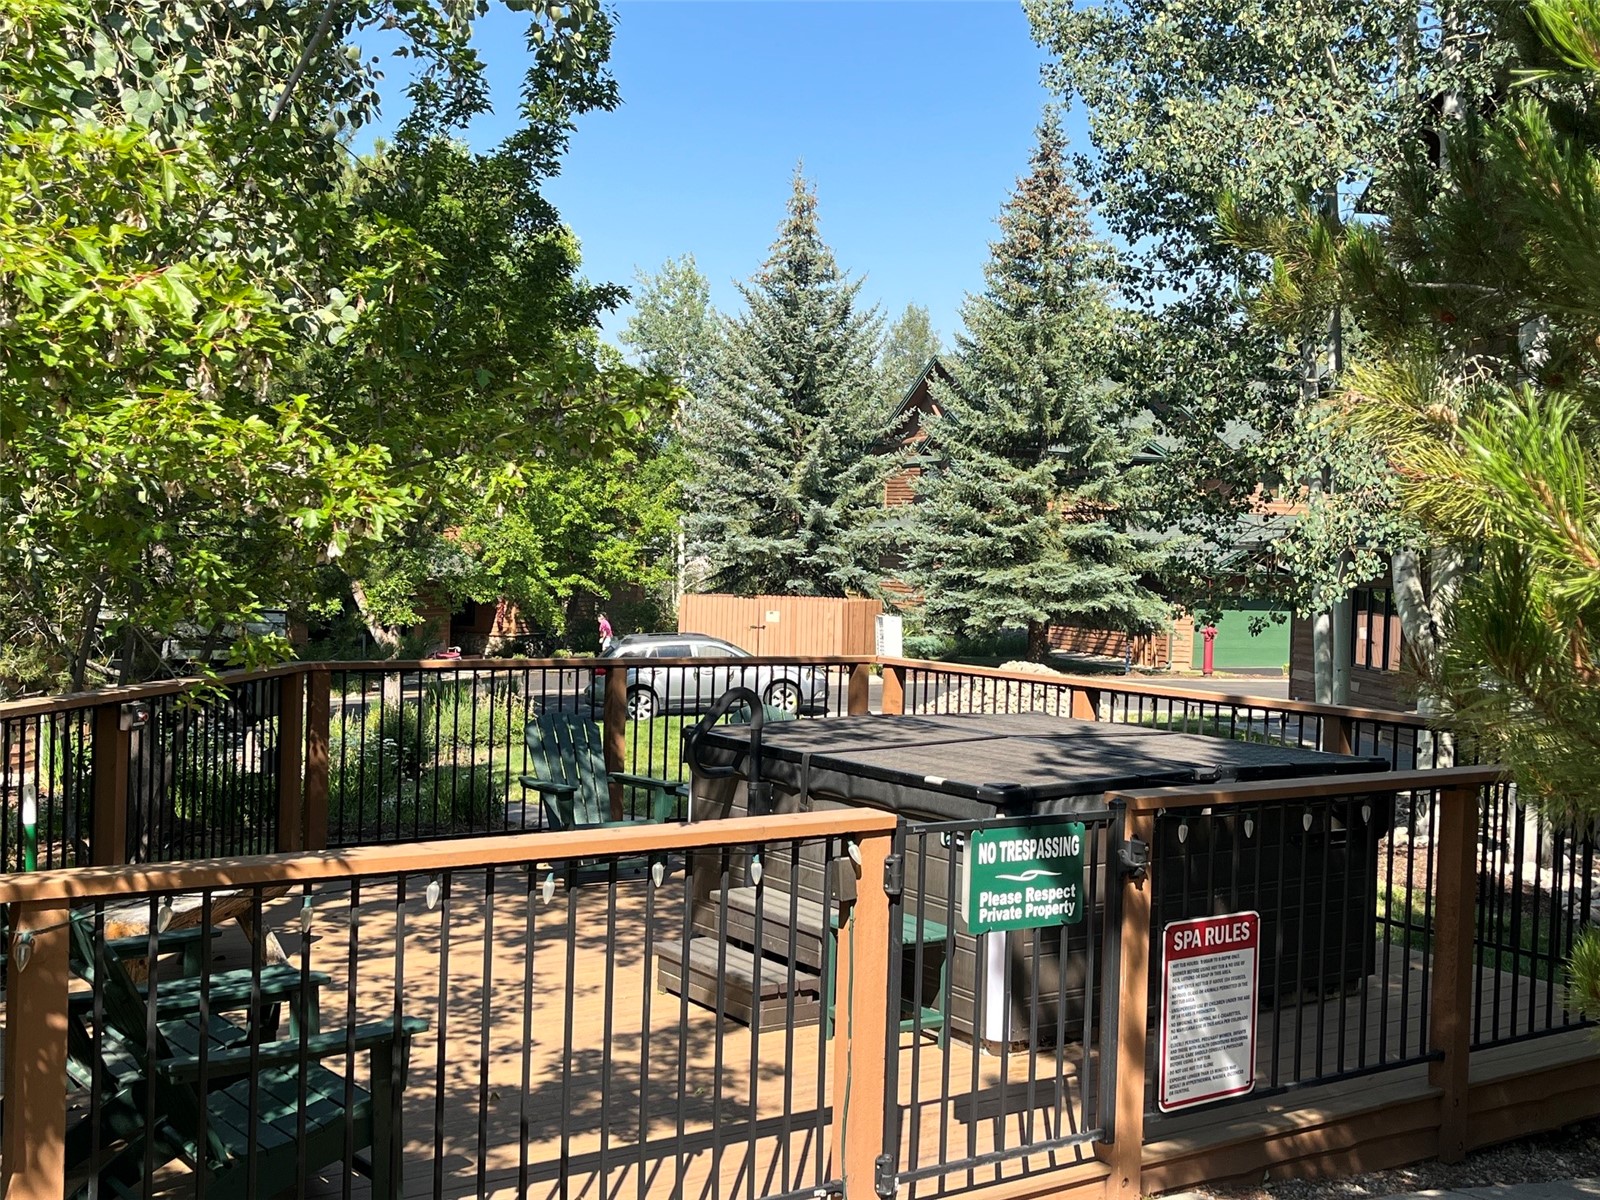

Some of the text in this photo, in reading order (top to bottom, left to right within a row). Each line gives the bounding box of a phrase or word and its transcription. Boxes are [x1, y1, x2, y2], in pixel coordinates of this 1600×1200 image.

[978, 835, 1080, 864] NO TRESPASSING
[980, 884, 1076, 908] Please Respect
[979, 900, 1075, 923] Private Property
[1173, 922, 1250, 952] SPA RULES
